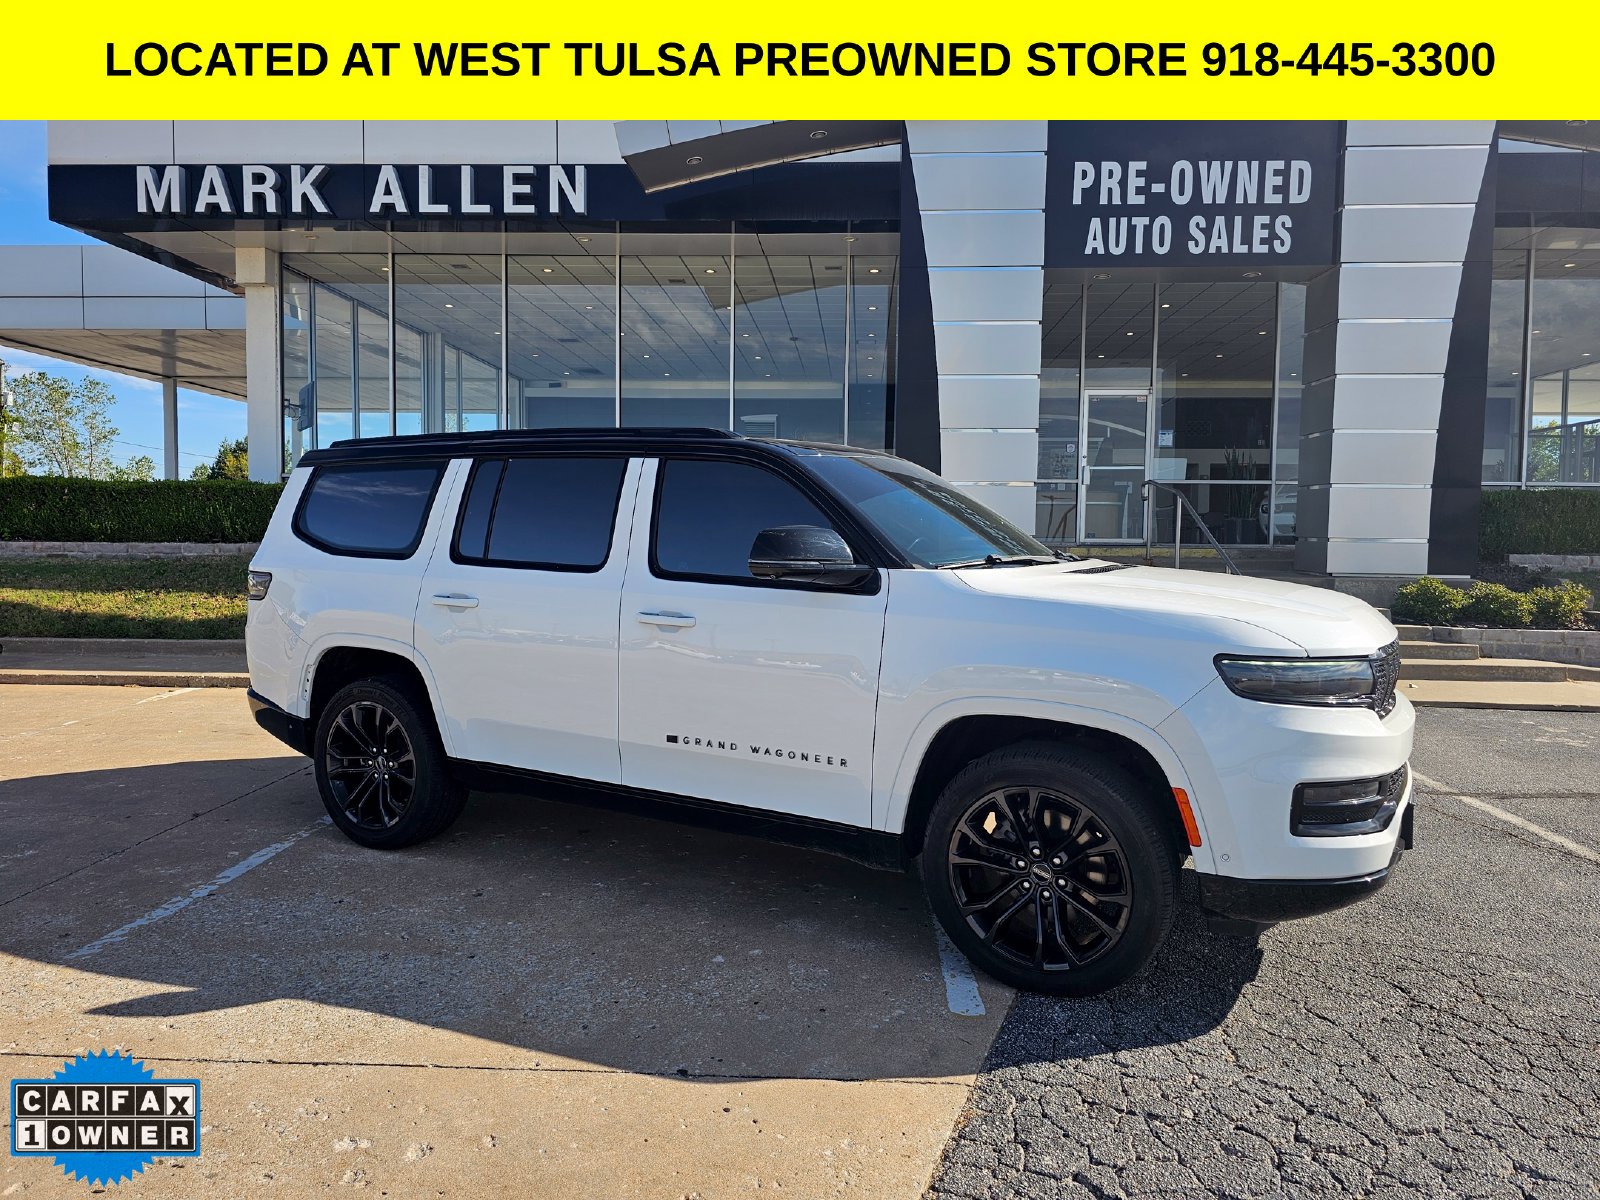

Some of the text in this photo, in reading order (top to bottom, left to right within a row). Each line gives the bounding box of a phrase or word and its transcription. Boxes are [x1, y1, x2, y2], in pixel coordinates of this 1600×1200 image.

[136, 164, 588, 217] MARK ALLEN
[1072, 160, 1312, 205] PRE-OWNED
[1084, 215, 1293, 255] AUTO SALES
[682, 736, 849, 768] GRAND WAGONEER
